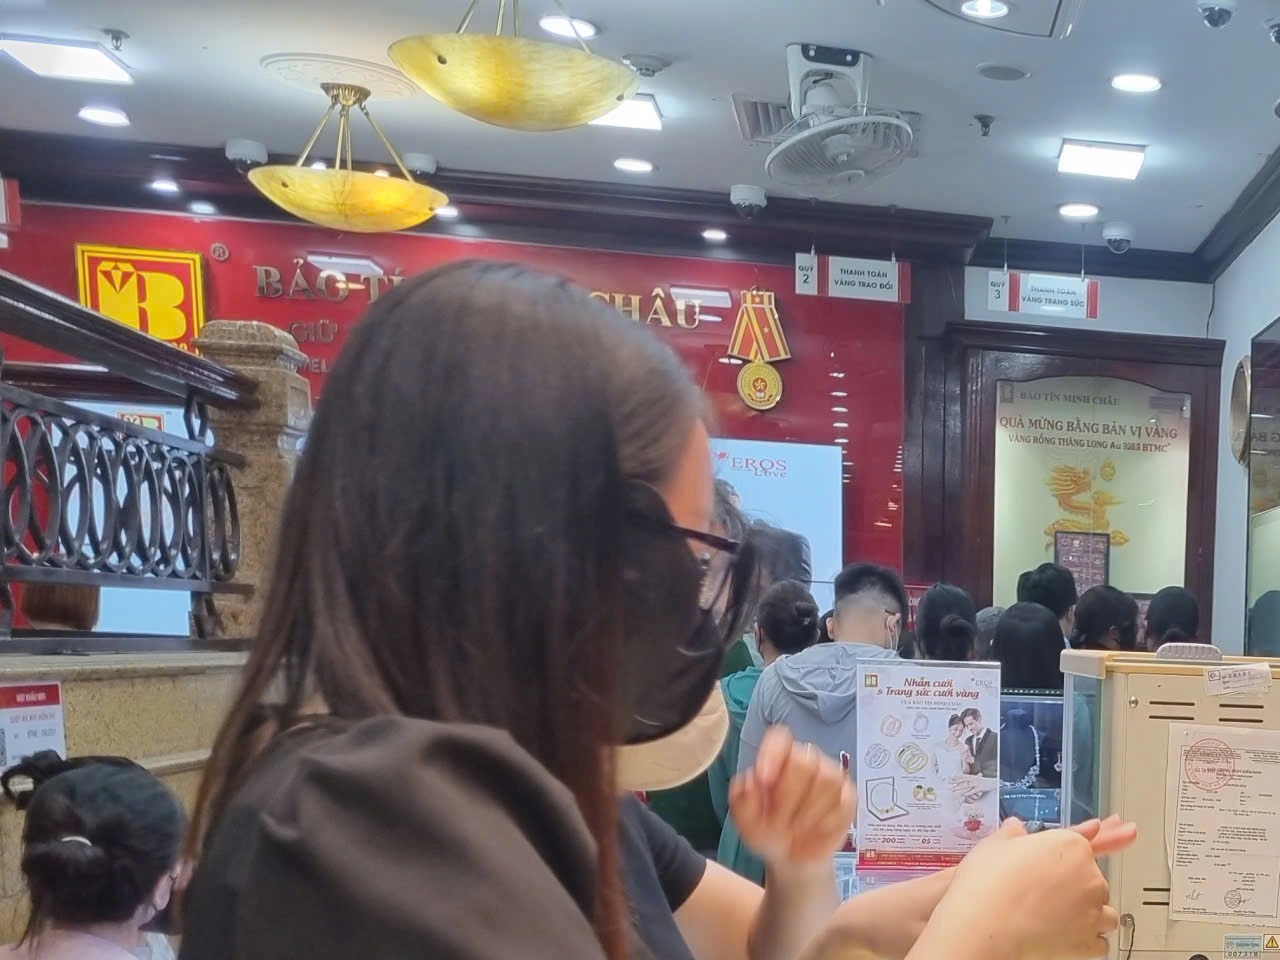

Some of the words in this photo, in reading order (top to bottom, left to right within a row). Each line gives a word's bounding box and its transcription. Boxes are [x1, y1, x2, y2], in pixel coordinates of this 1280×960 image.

[253, 257, 350, 302] BẢO
[802, 273, 810, 284] 2
[839, 268, 866, 278] THANH
[866, 269, 889, 279] TOÁN
[834, 279, 857, 288] VÀNG
[858, 280, 878, 289] TRAO
[879, 281, 894, 290] ĐỔI
[994, 289, 1001, 299] 3
[1021, 295, 1043, 304] VÀNG
[1044, 297, 1069, 306] TRANG
[1063, 394, 1091, 405] MINH
[1092, 395, 1121, 407] CHÂU
[999, 414, 1026, 429] QUÀ
[1027, 416, 1064, 432] MỪNG
[1066, 415, 1100, 434] BẰNG
[1102, 419, 1128, 436] BẢN
[1130, 425, 1142, 439] VỊ
[1144, 425, 1178, 440] VÀNG
[1008, 433, 1032, 444] VÀNG
[1033, 432, 1056, 446] RỒNG
[1086, 439, 1109, 450] LONG
[1110, 441, 1122, 450] Au
[731, 456, 788, 472] EROS
[903, 676, 931, 688] Nhẫn
[933, 678, 954, 688] cưới
[885, 686, 913, 698] Trang
[915, 686, 932, 697] sức
[933, 687, 954, 698] cưới
[956, 688, 980, 700] vàng
